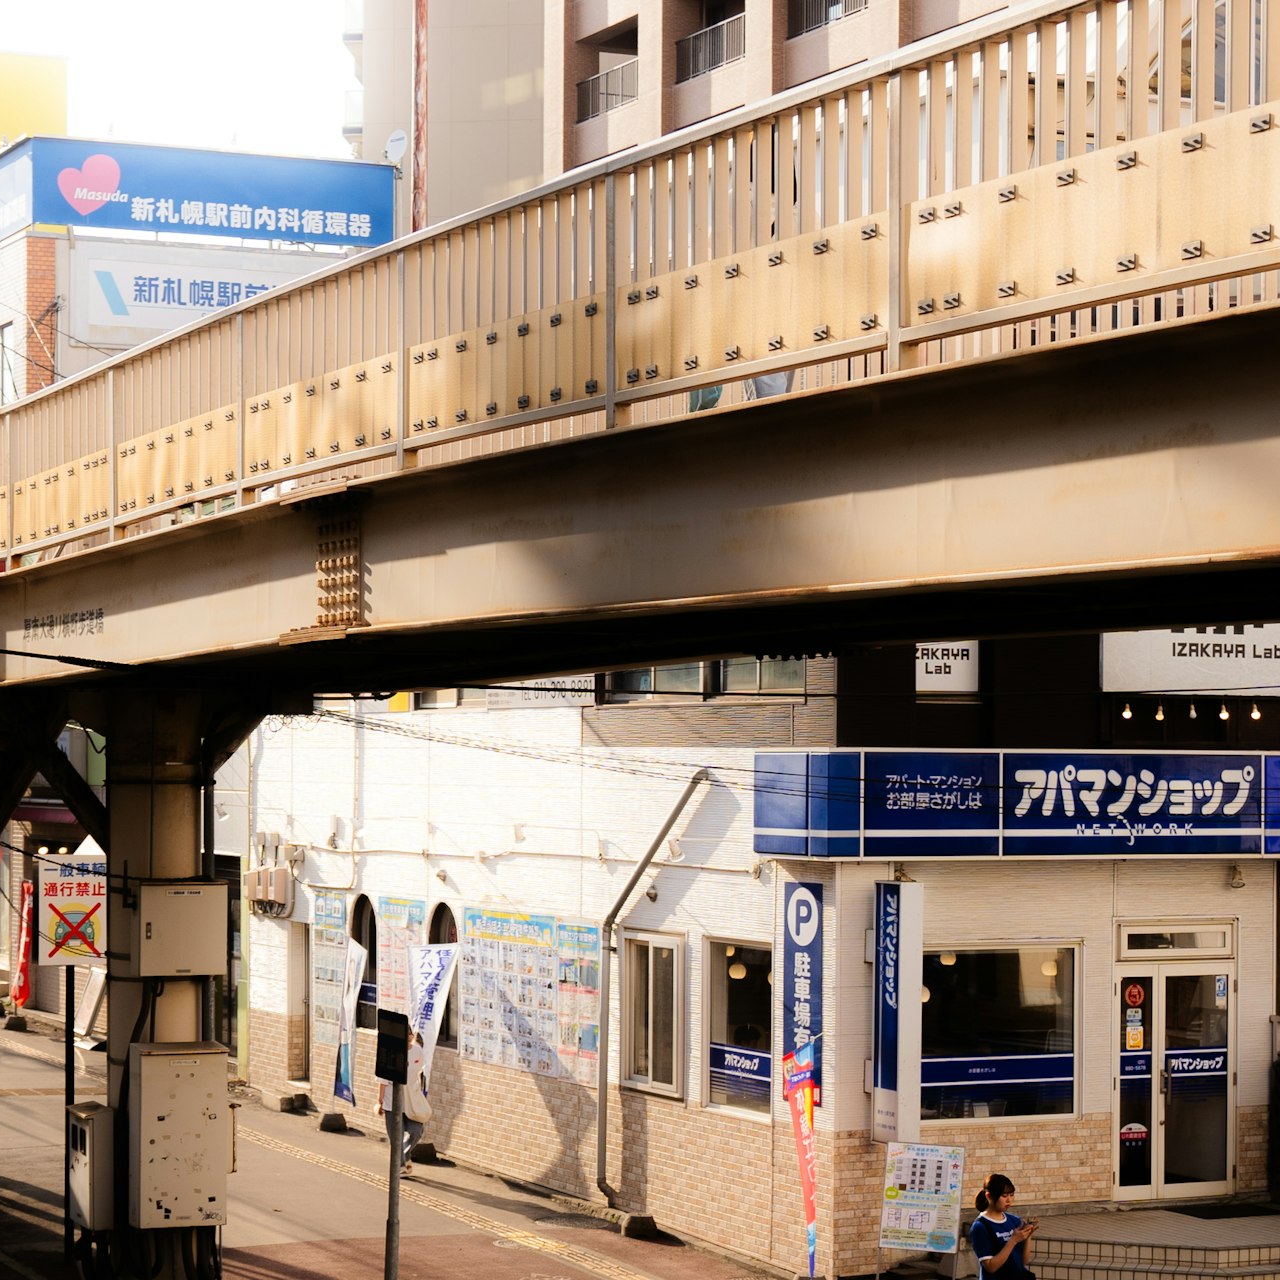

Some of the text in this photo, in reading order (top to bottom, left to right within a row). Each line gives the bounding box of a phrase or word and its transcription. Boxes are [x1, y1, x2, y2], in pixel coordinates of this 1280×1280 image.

[74, 187, 129, 203] Masuda
[131, 196, 372, 238] 新札幌駅前内科循環器
[1172, 642, 1246, 659] IZAKAYA
[925, 661, 952, 675] Lab
[885, 774, 982, 789] アパート・マンション
[1014, 764, 1256, 818] アパマンショップ
[885, 791, 982, 810] お部屋さがしは
[43, 881, 107, 897] 通行禁止
[886, 893, 899, 1010] アパマンショップ
